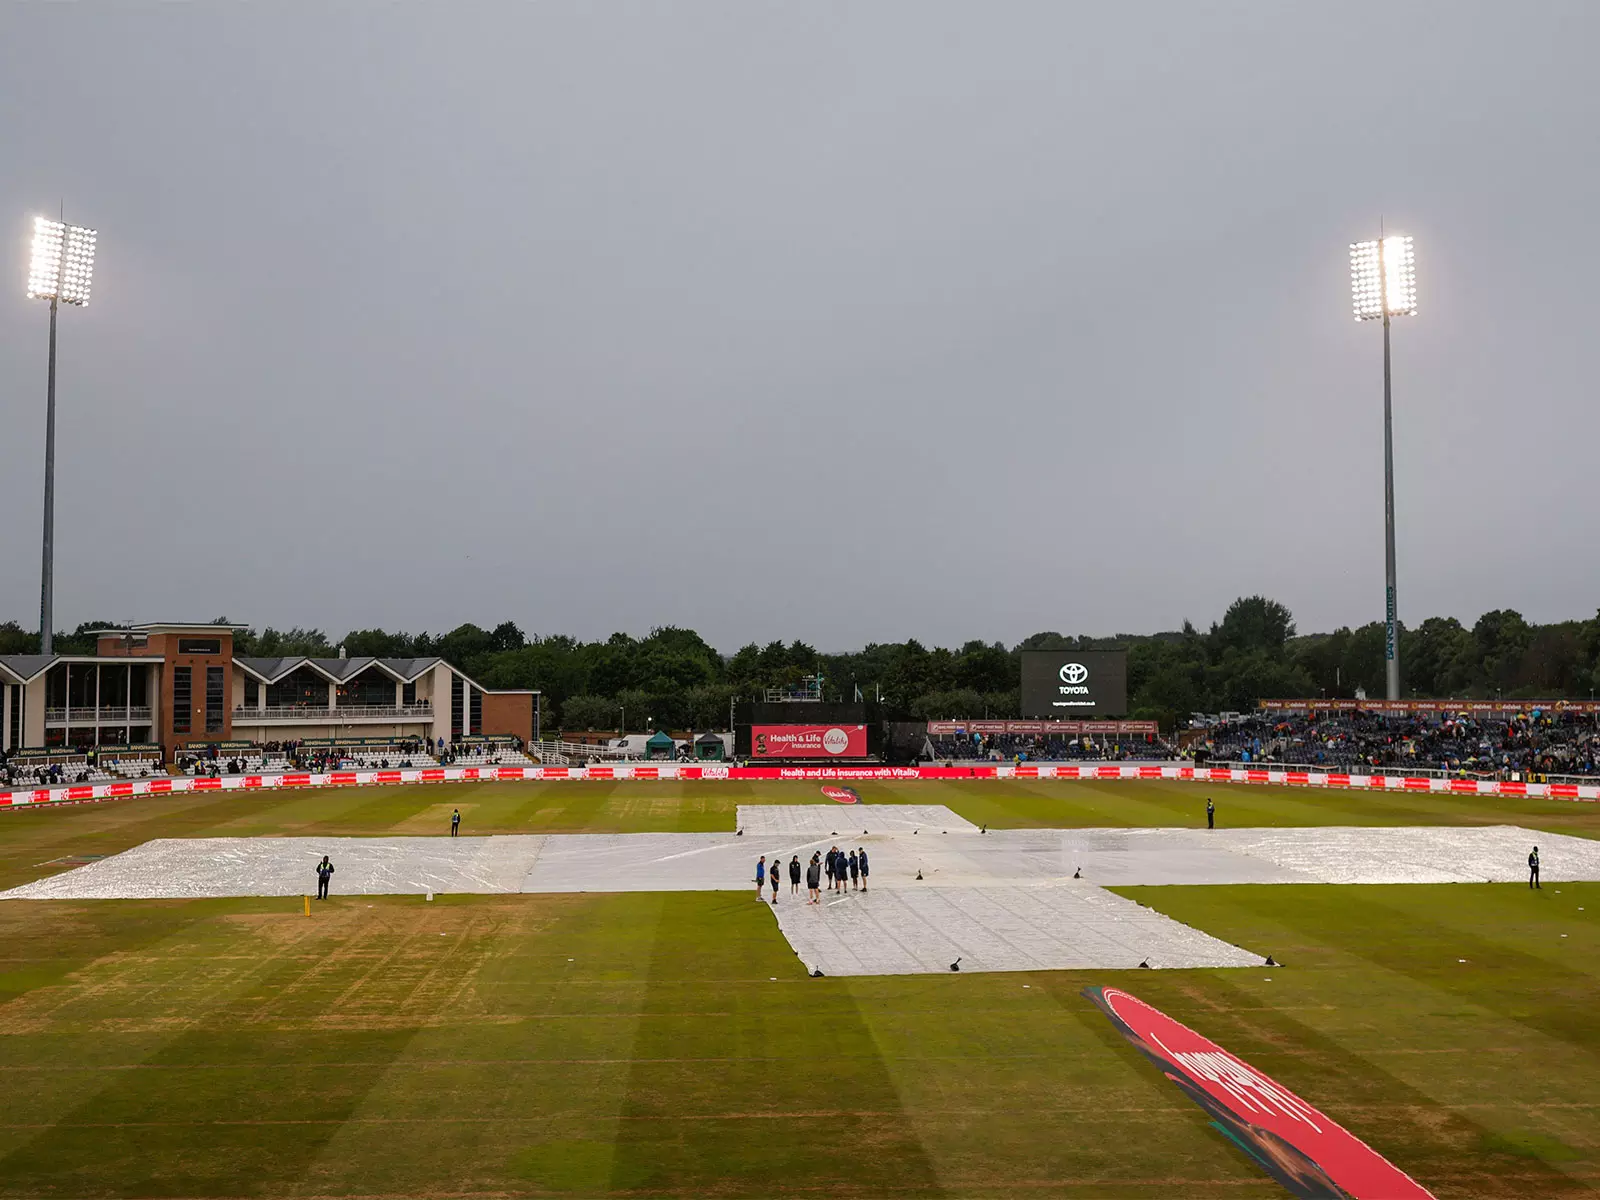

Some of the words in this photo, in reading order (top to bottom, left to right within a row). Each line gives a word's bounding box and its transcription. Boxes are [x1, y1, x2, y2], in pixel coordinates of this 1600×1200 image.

[1059, 686, 1089, 695] TOYOTA
[770, 734, 797, 742] Health
[806, 734, 821, 742] Life
[824, 735, 848, 745] Vitality
[781, 768, 805, 777] Health
[806, 768, 821, 777] and
[822, 768, 836, 777] Life
[837, 768, 873, 777] insurance
[874, 768, 892, 777] with
[892, 768, 920, 778] Vitality
